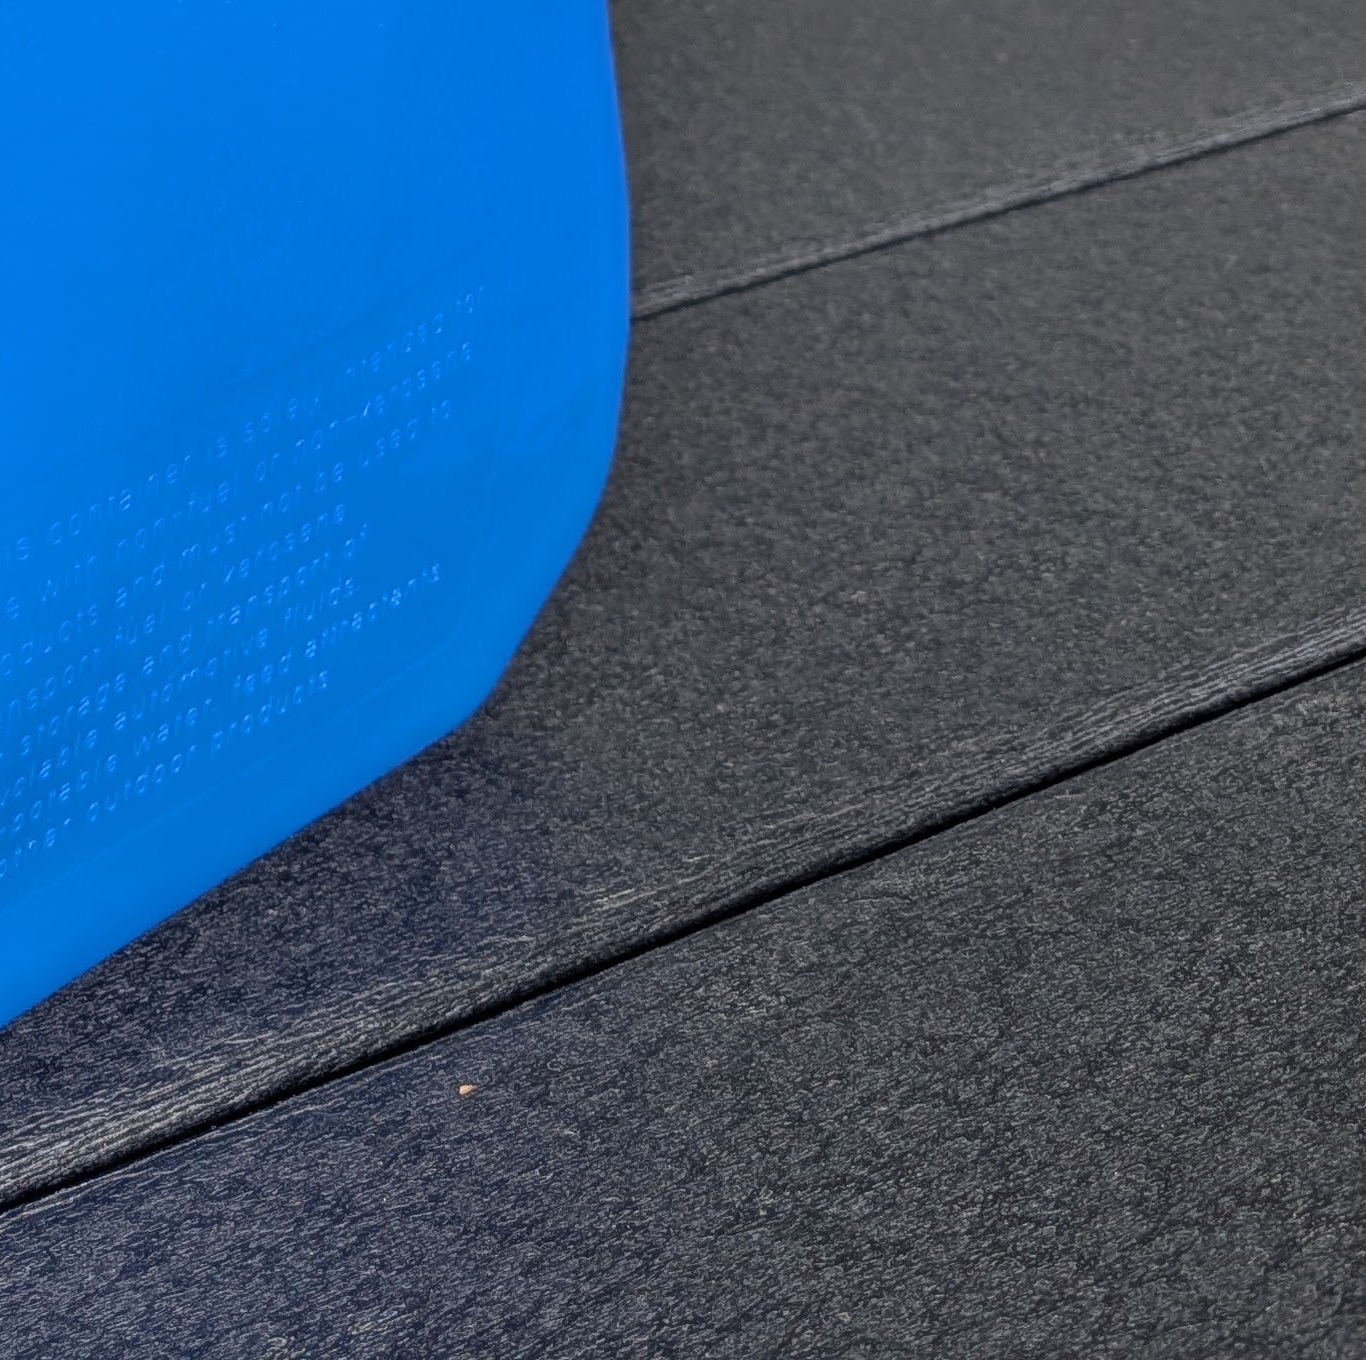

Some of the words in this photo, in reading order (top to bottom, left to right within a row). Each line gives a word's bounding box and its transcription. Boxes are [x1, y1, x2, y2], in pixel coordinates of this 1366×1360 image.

[38, 546, 97, 602] with
[116, 470, 238, 565] non-fuel
[255, 451, 280, 481] or
[294, 342, 472, 465] non-kerosene
[50, 453, 192, 546] container
[206, 435, 228, 462] is
[244, 384, 322, 443] solely
[336, 306, 443, 392] intended
[455, 284, 484, 320] for
[115, 554, 165, 608] and
[182, 509, 248, 570] must
[262, 478, 304, 520] not
[314, 461, 344, 493] be
[359, 412, 419, 468] used
[430, 397, 451, 426] to
[20, 672, 125, 756] storage
[143, 626, 192, 675] and
[207, 548, 331, 643] transport
[345, 521, 367, 559] of
[114, 598, 166, 648] fuel
[184, 581, 208, 611] or
[222, 504, 346, 584] kerosene
[234, 647, 293, 693] feed
[304, 563, 440, 658] attractants
[87, 743, 201, 823] outdoor
[211, 670, 327, 761] products
[114, 627, 269, 731] automotive
